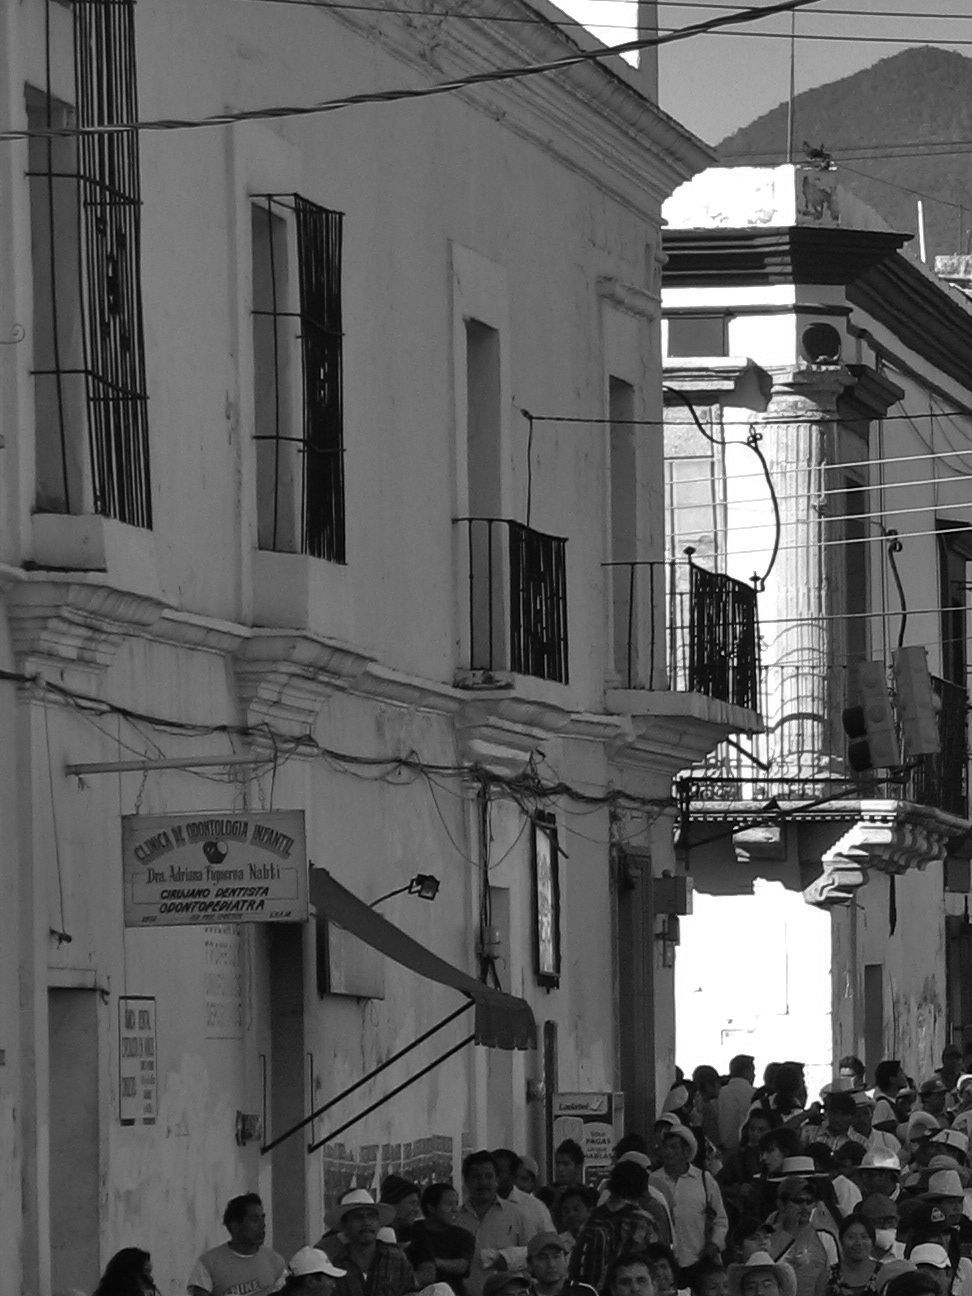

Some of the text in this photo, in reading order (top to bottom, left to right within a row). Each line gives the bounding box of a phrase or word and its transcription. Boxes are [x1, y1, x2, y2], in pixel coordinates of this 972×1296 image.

[134, 819, 295, 862] CLINICA DE ODONTOLOGIA INFANTIL
[160, 886, 270, 900] CIRUJANO DENTISTA
[159, 900, 266, 913] ODONTOPEDIATRA
